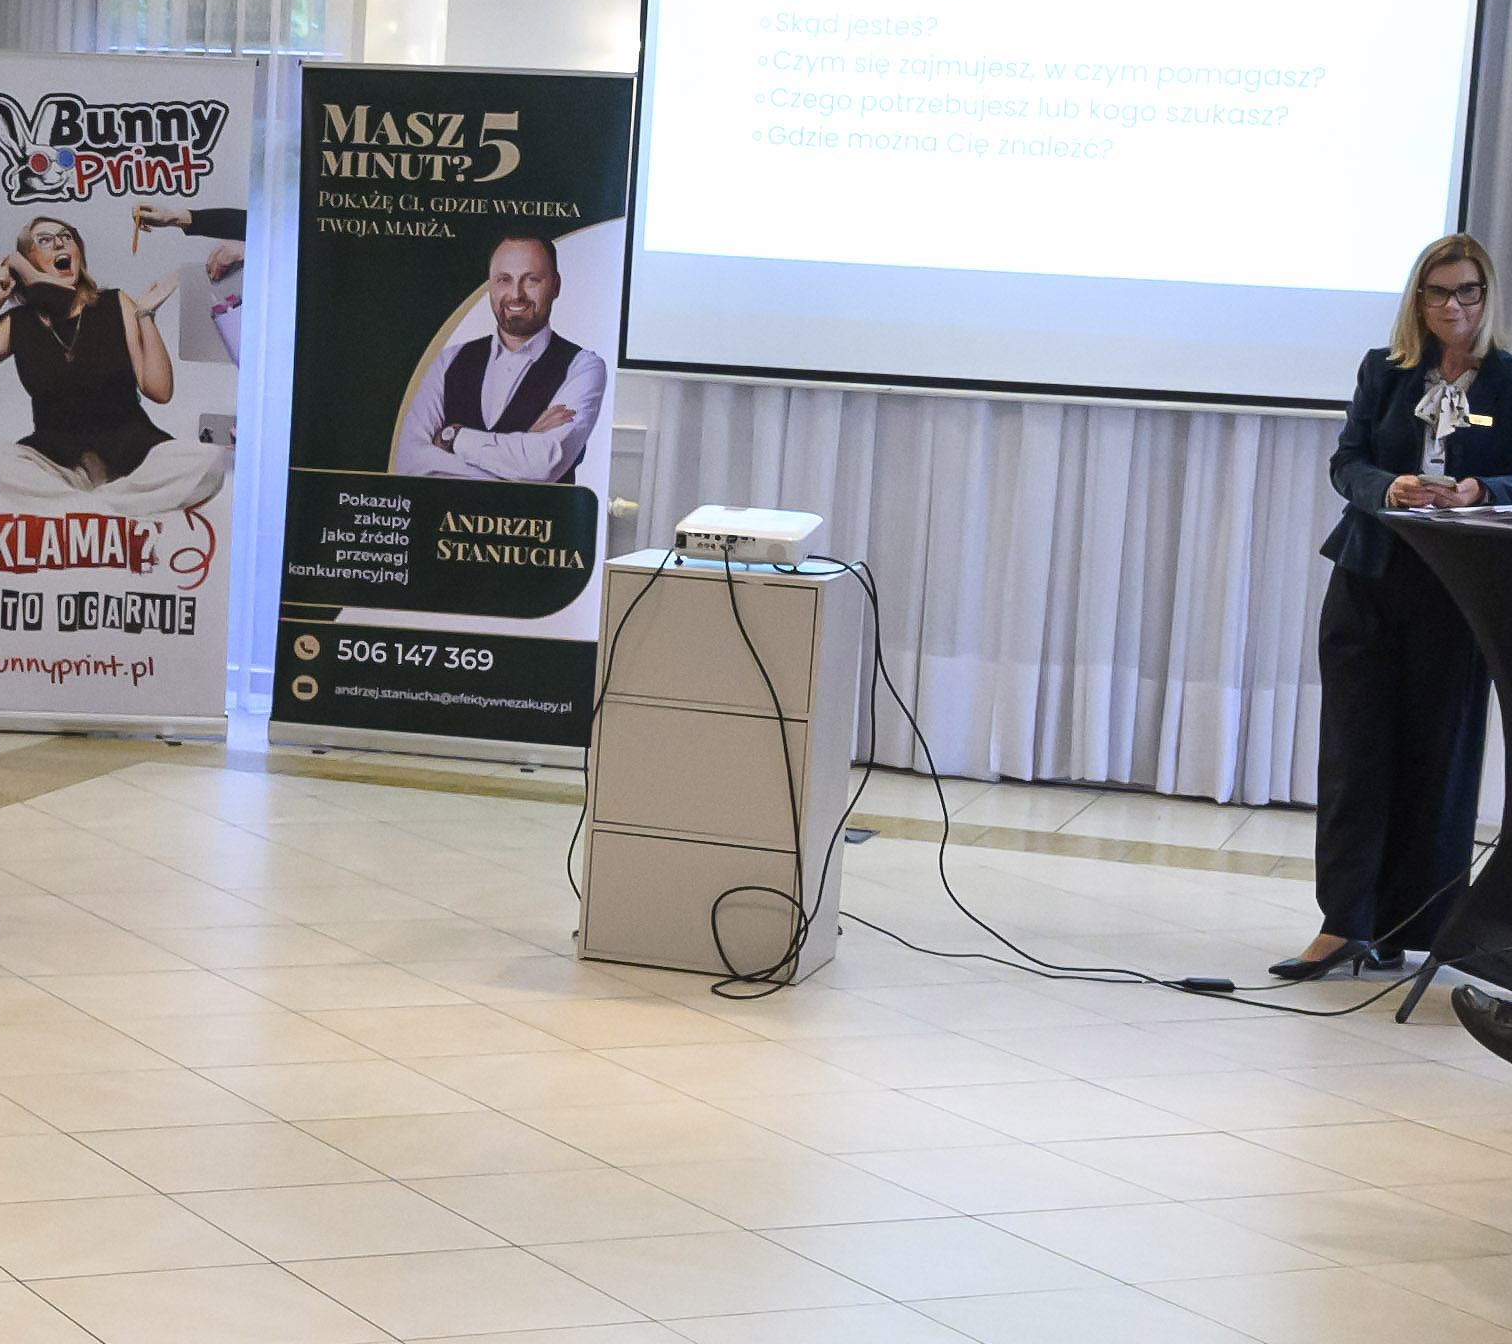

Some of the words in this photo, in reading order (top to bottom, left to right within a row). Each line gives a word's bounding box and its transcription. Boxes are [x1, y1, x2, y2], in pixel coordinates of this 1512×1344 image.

[775, 11, 839, 39] Skąd
[845, 12, 938, 42] jesteś?
[772, 49, 846, 78] Czym
[855, 51, 890, 79] się
[898, 53, 1034, 84] zajmujesz,
[1044, 63, 1067, 79] w
[1074, 63, 1147, 88] czym
[1156, 65, 1326, 93] pomagasz?
[769, 87, 853, 117] Czego
[860, 92, 1030, 123] potrzebujesz
[1037, 96, 1080, 120] lub
[1088, 98, 1157, 128] kogo
[1165, 102, 1289, 127] szukasz?
[49, 99, 223, 151] Bunny
[767, 124, 839, 147] Gdzie
[945, 131, 989, 158] Cię
[472, 110, 521, 182] 5
[320, 150, 473, 183] MINUT?
[430, 196, 488, 214] GDZIE
[492, 199, 581, 218] WYCIEKA
[317, 217, 379, 238] TWOJA
[384, 218, 456, 238] MARŻA.
[338, 492, 412, 512] Pokazuję
[320, 527, 356, 544] jako
[359, 529, 409, 546] źródło
[353, 512, 411, 529] zakupy
[439, 510, 554, 543] ANDRZEJ
[335, 547, 409, 565] przewagi
[436, 538, 585, 570] STANIUCHA
[288, 563, 409, 585] konkurencyjnej
[2, 593, 41, 628] TO
[59, 593, 195, 631] OGARNIE
[336, 639, 387, 664] 506
[394, 642, 437, 667] 147
[443, 647, 494, 671] 369
